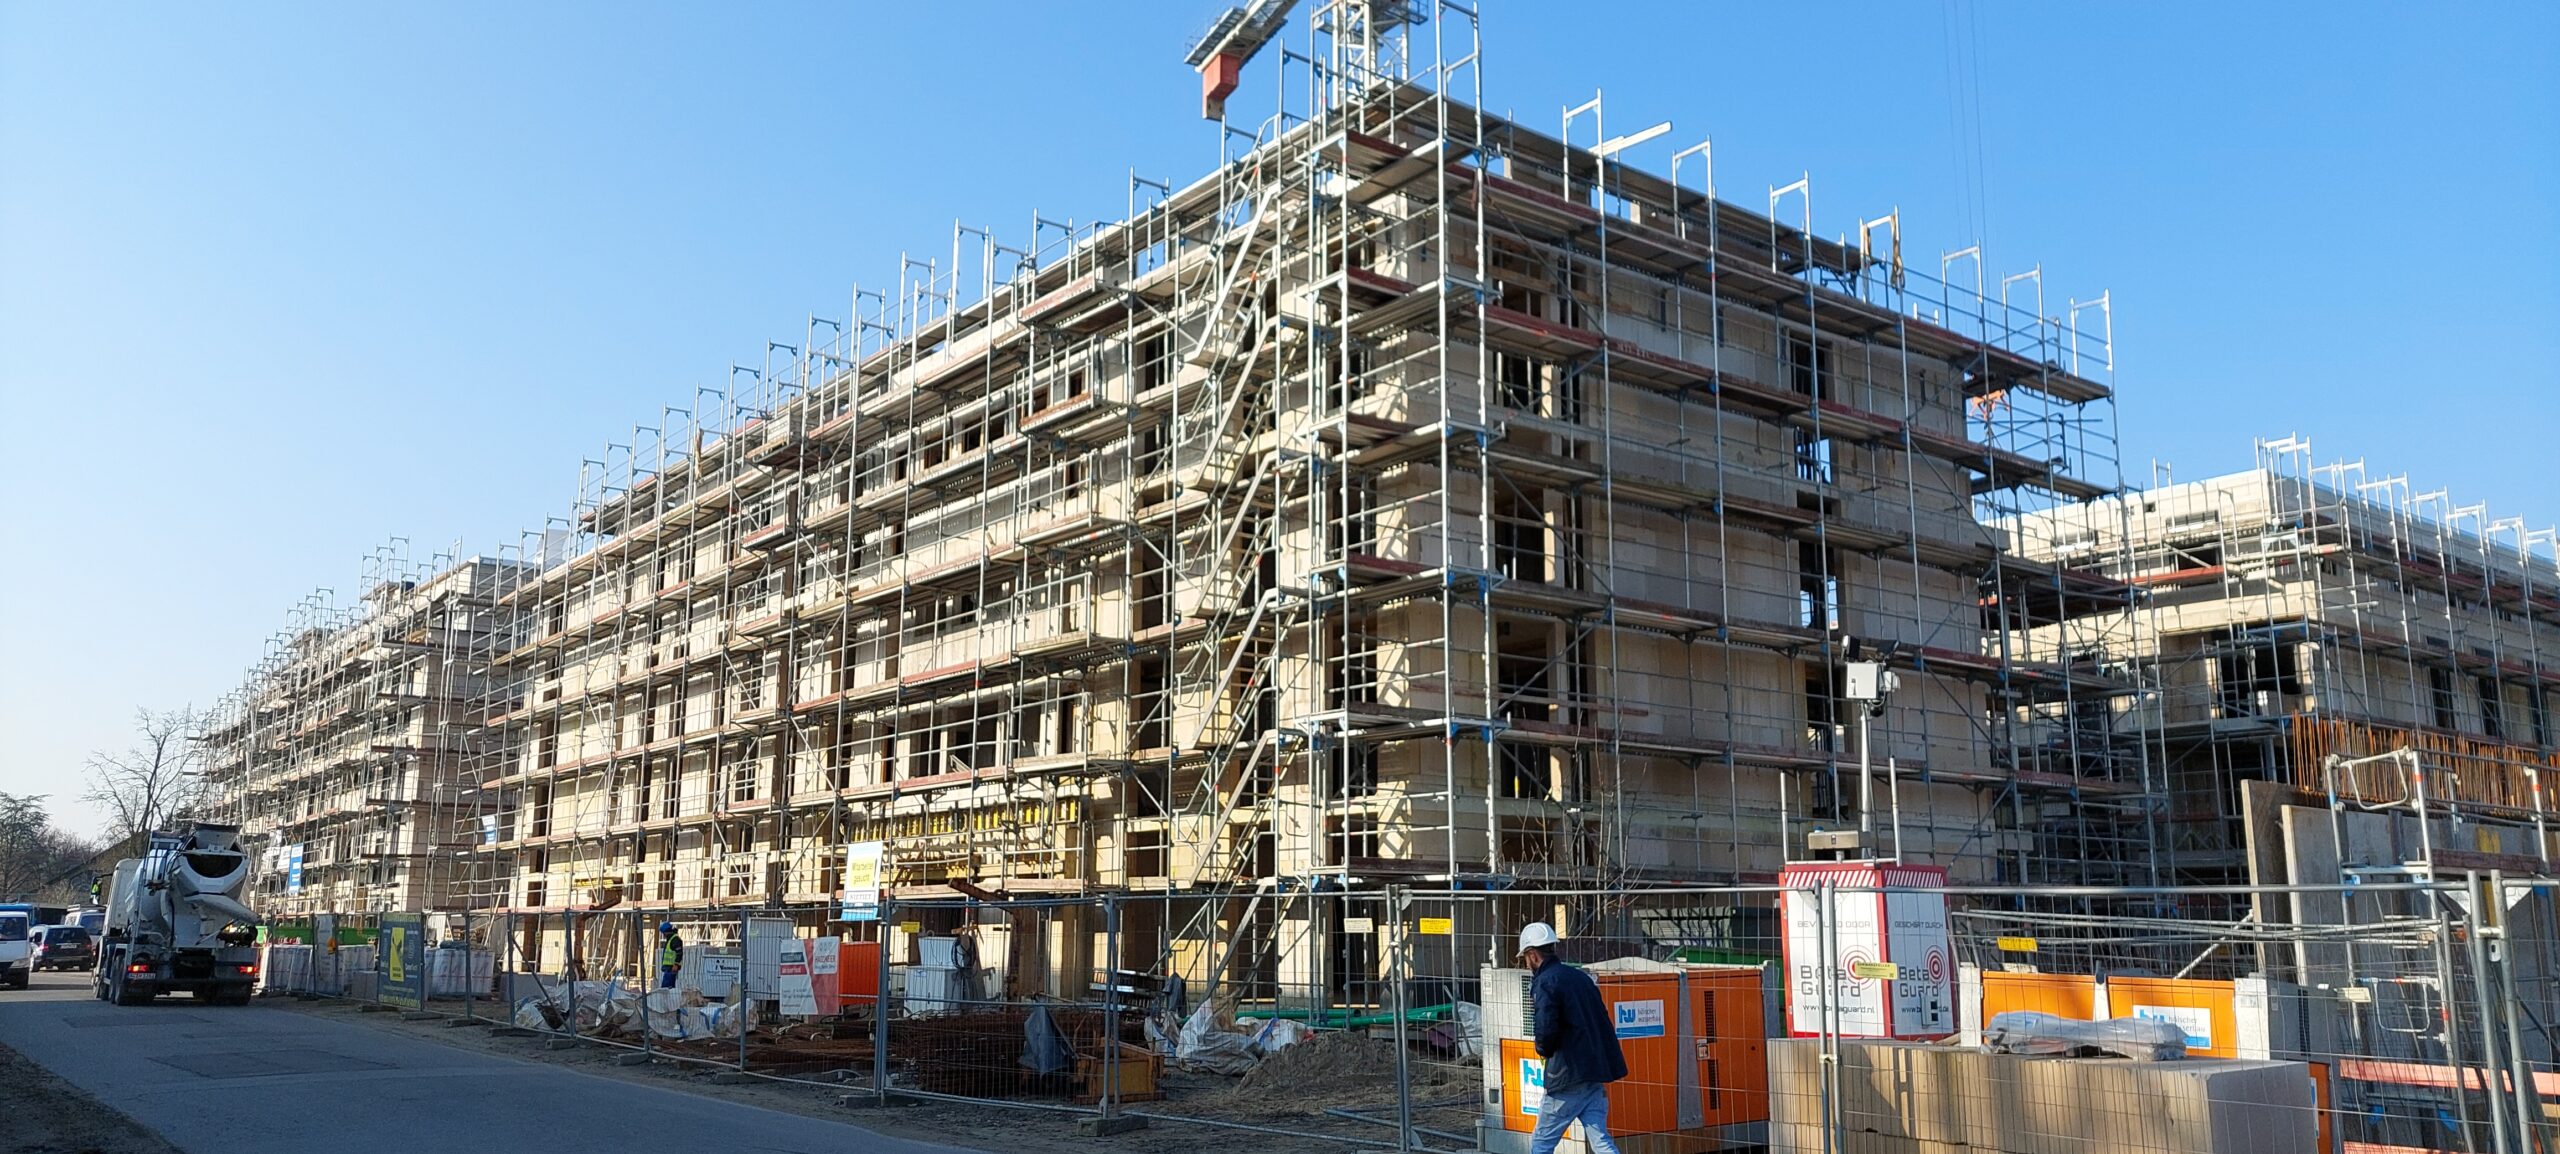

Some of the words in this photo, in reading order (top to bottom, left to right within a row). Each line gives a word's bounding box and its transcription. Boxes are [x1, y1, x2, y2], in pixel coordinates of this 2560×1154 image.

[1797, 920, 1843, 929] BEVLD
[1845, 920, 1871, 929] DOOR
[1898, 965, 1930, 981] Beta
[1899, 983, 1939, 998] Guard
